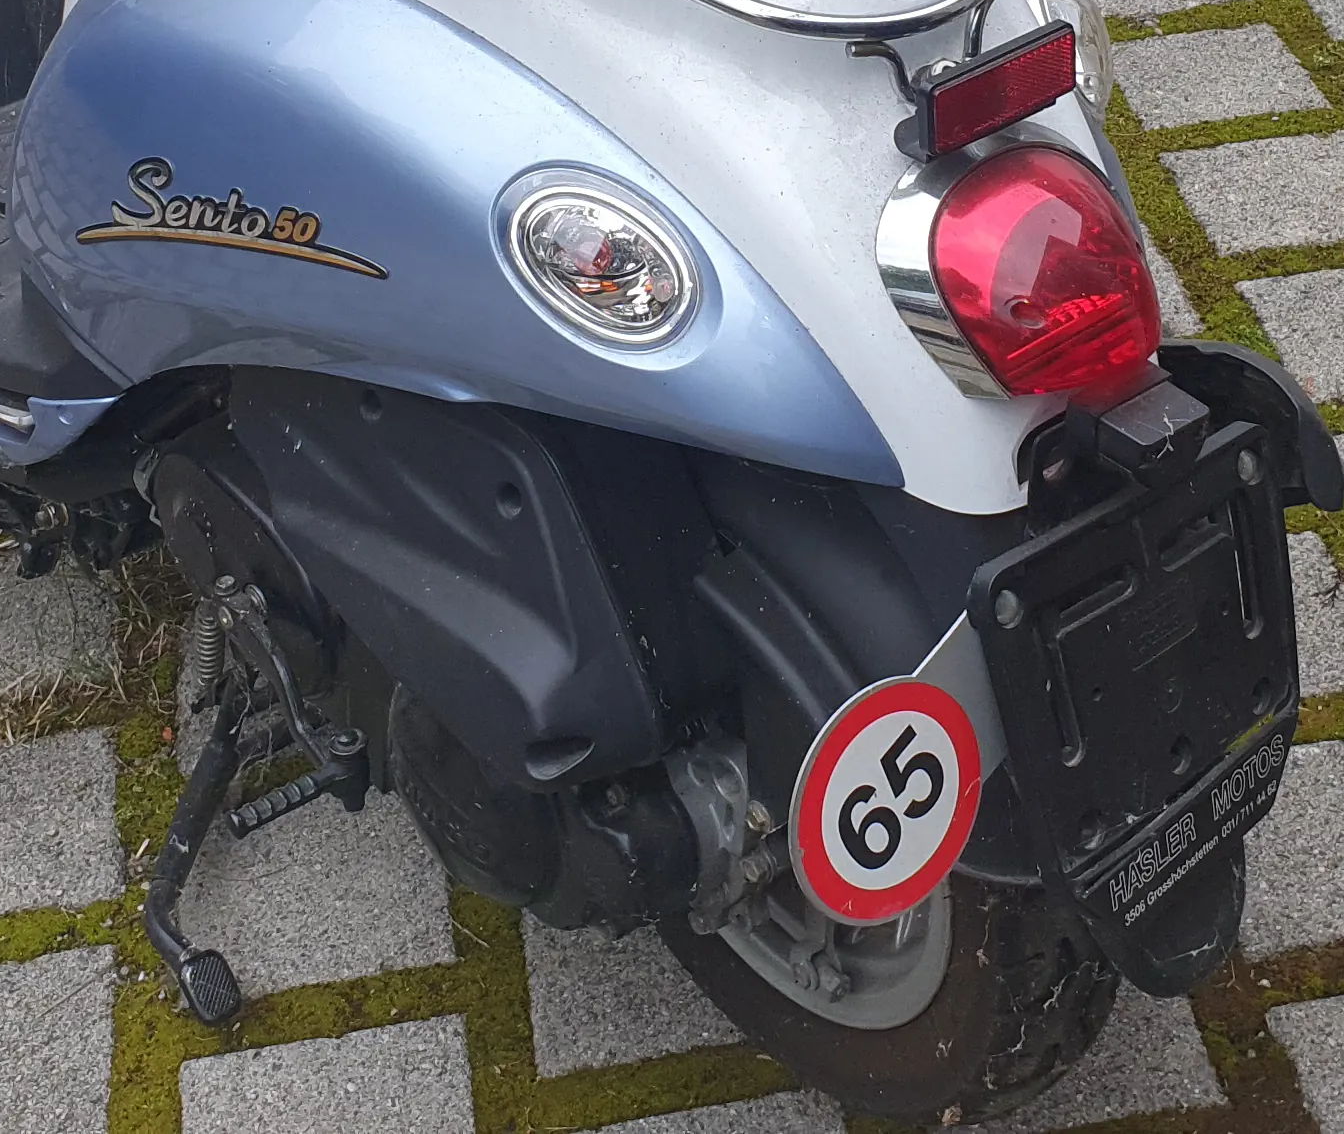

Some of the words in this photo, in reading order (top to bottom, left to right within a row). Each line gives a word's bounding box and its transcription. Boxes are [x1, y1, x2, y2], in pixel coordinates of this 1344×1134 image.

[111, 156, 269, 238] Sento
[271, 207, 319, 243] 50
[837, 723, 945, 870] 65
[1109, 812, 1197, 912] HASLER
[1210, 734, 1285, 821] MOTOS
[1124, 900, 1146, 927] 3506
